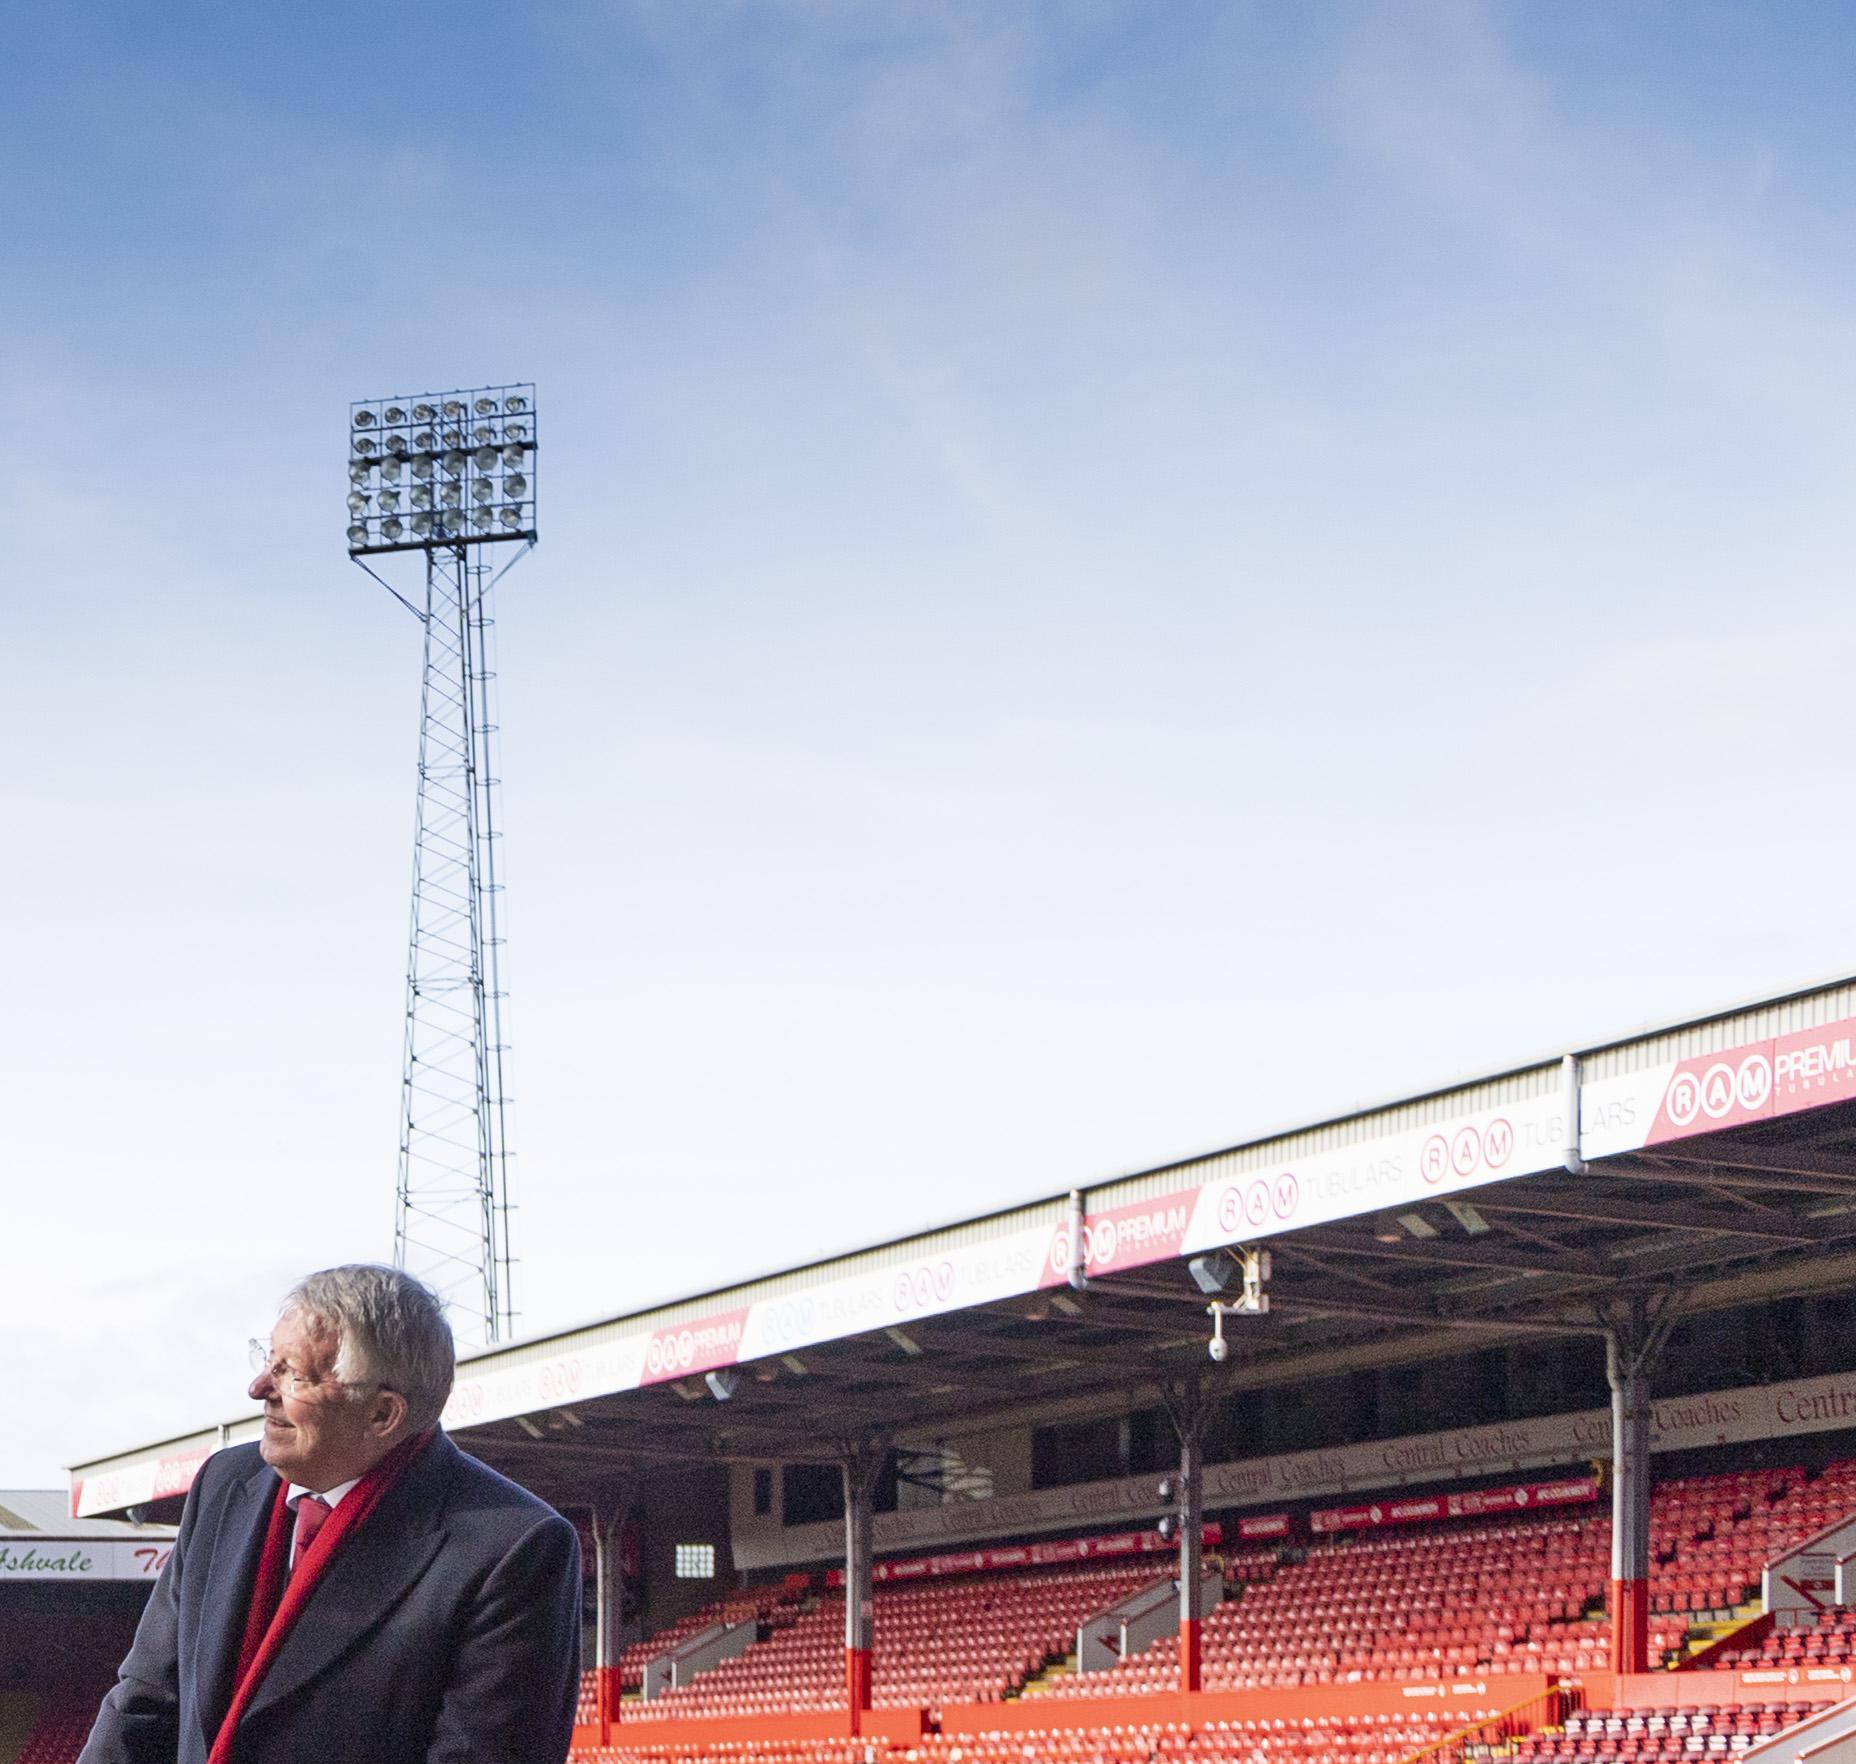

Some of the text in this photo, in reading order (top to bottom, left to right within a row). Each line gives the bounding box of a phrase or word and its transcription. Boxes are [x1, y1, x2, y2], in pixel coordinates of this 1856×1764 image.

[1669, 1039, 1856, 1122] RAM PREMIU
[1220, 1175, 1298, 1230] RAM
[1422, 1120, 1512, 1182] RAM
[1117, 1207, 1186, 1241] PREMIUM
[134, 1548, 168, 1572] Th
